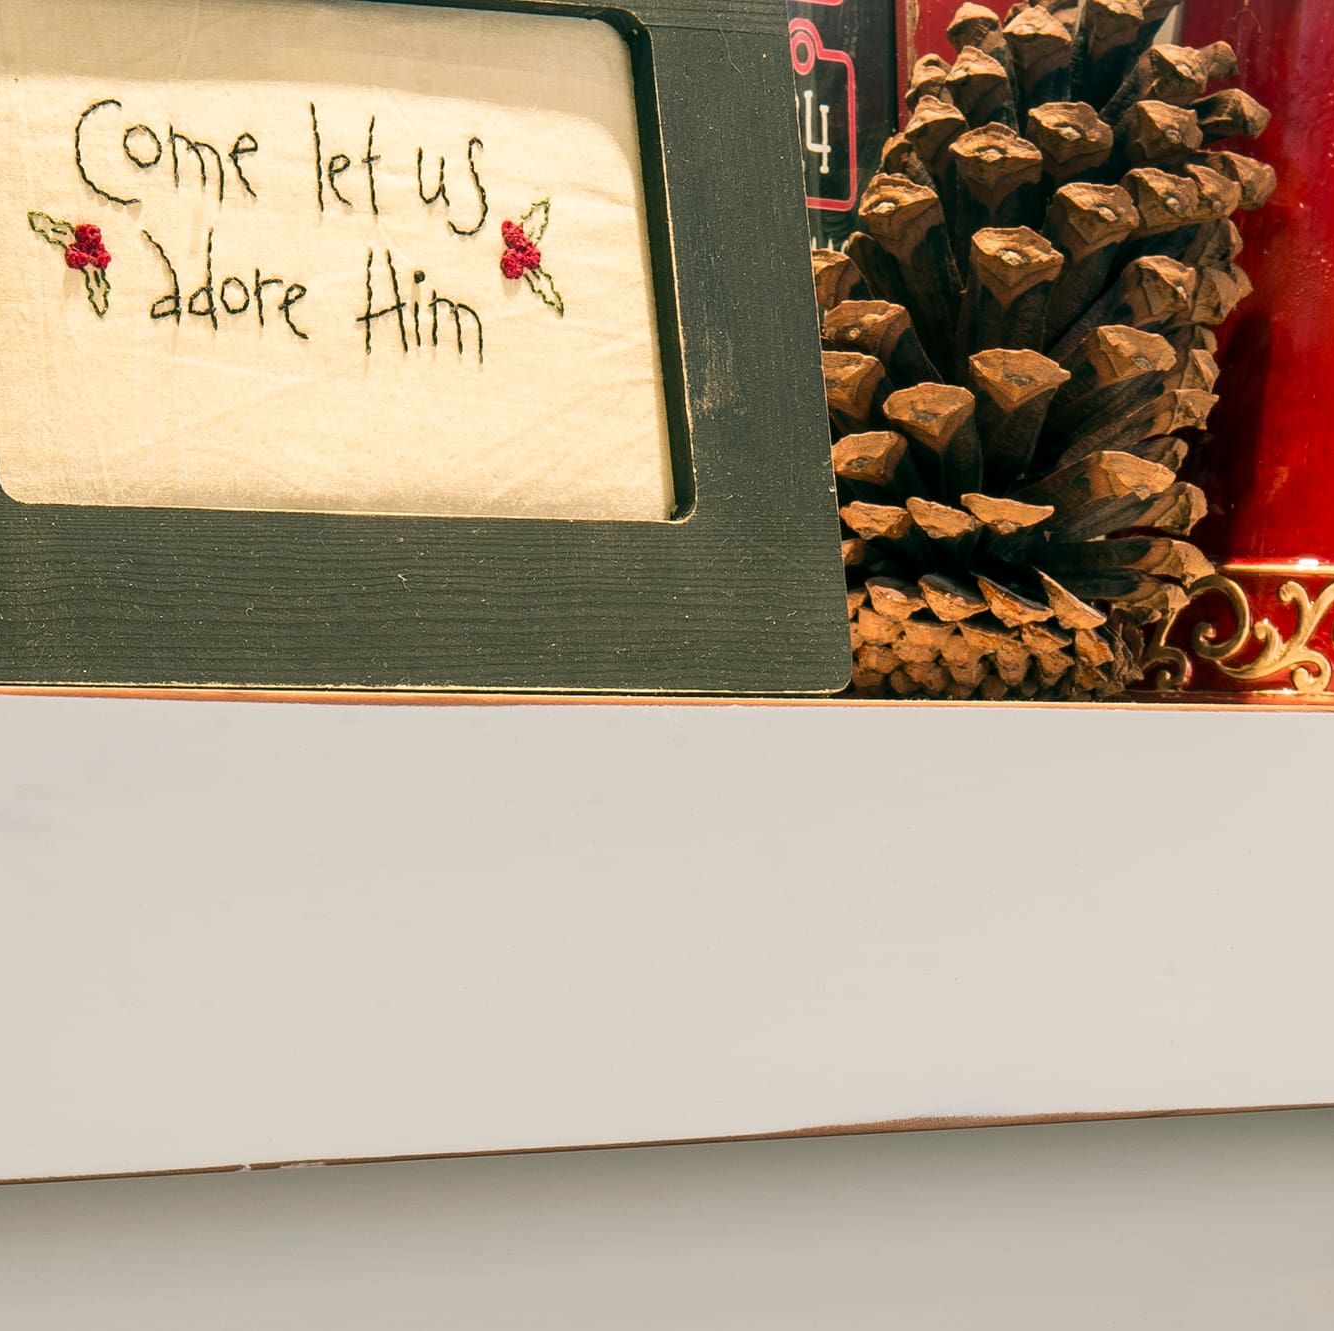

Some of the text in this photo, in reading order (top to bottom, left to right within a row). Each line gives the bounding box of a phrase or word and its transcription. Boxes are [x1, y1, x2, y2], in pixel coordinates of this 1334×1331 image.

[75, 99, 489, 236] Come let us
[795, 90, 831, 174] 4
[142, 227, 483, 364] adore Him
